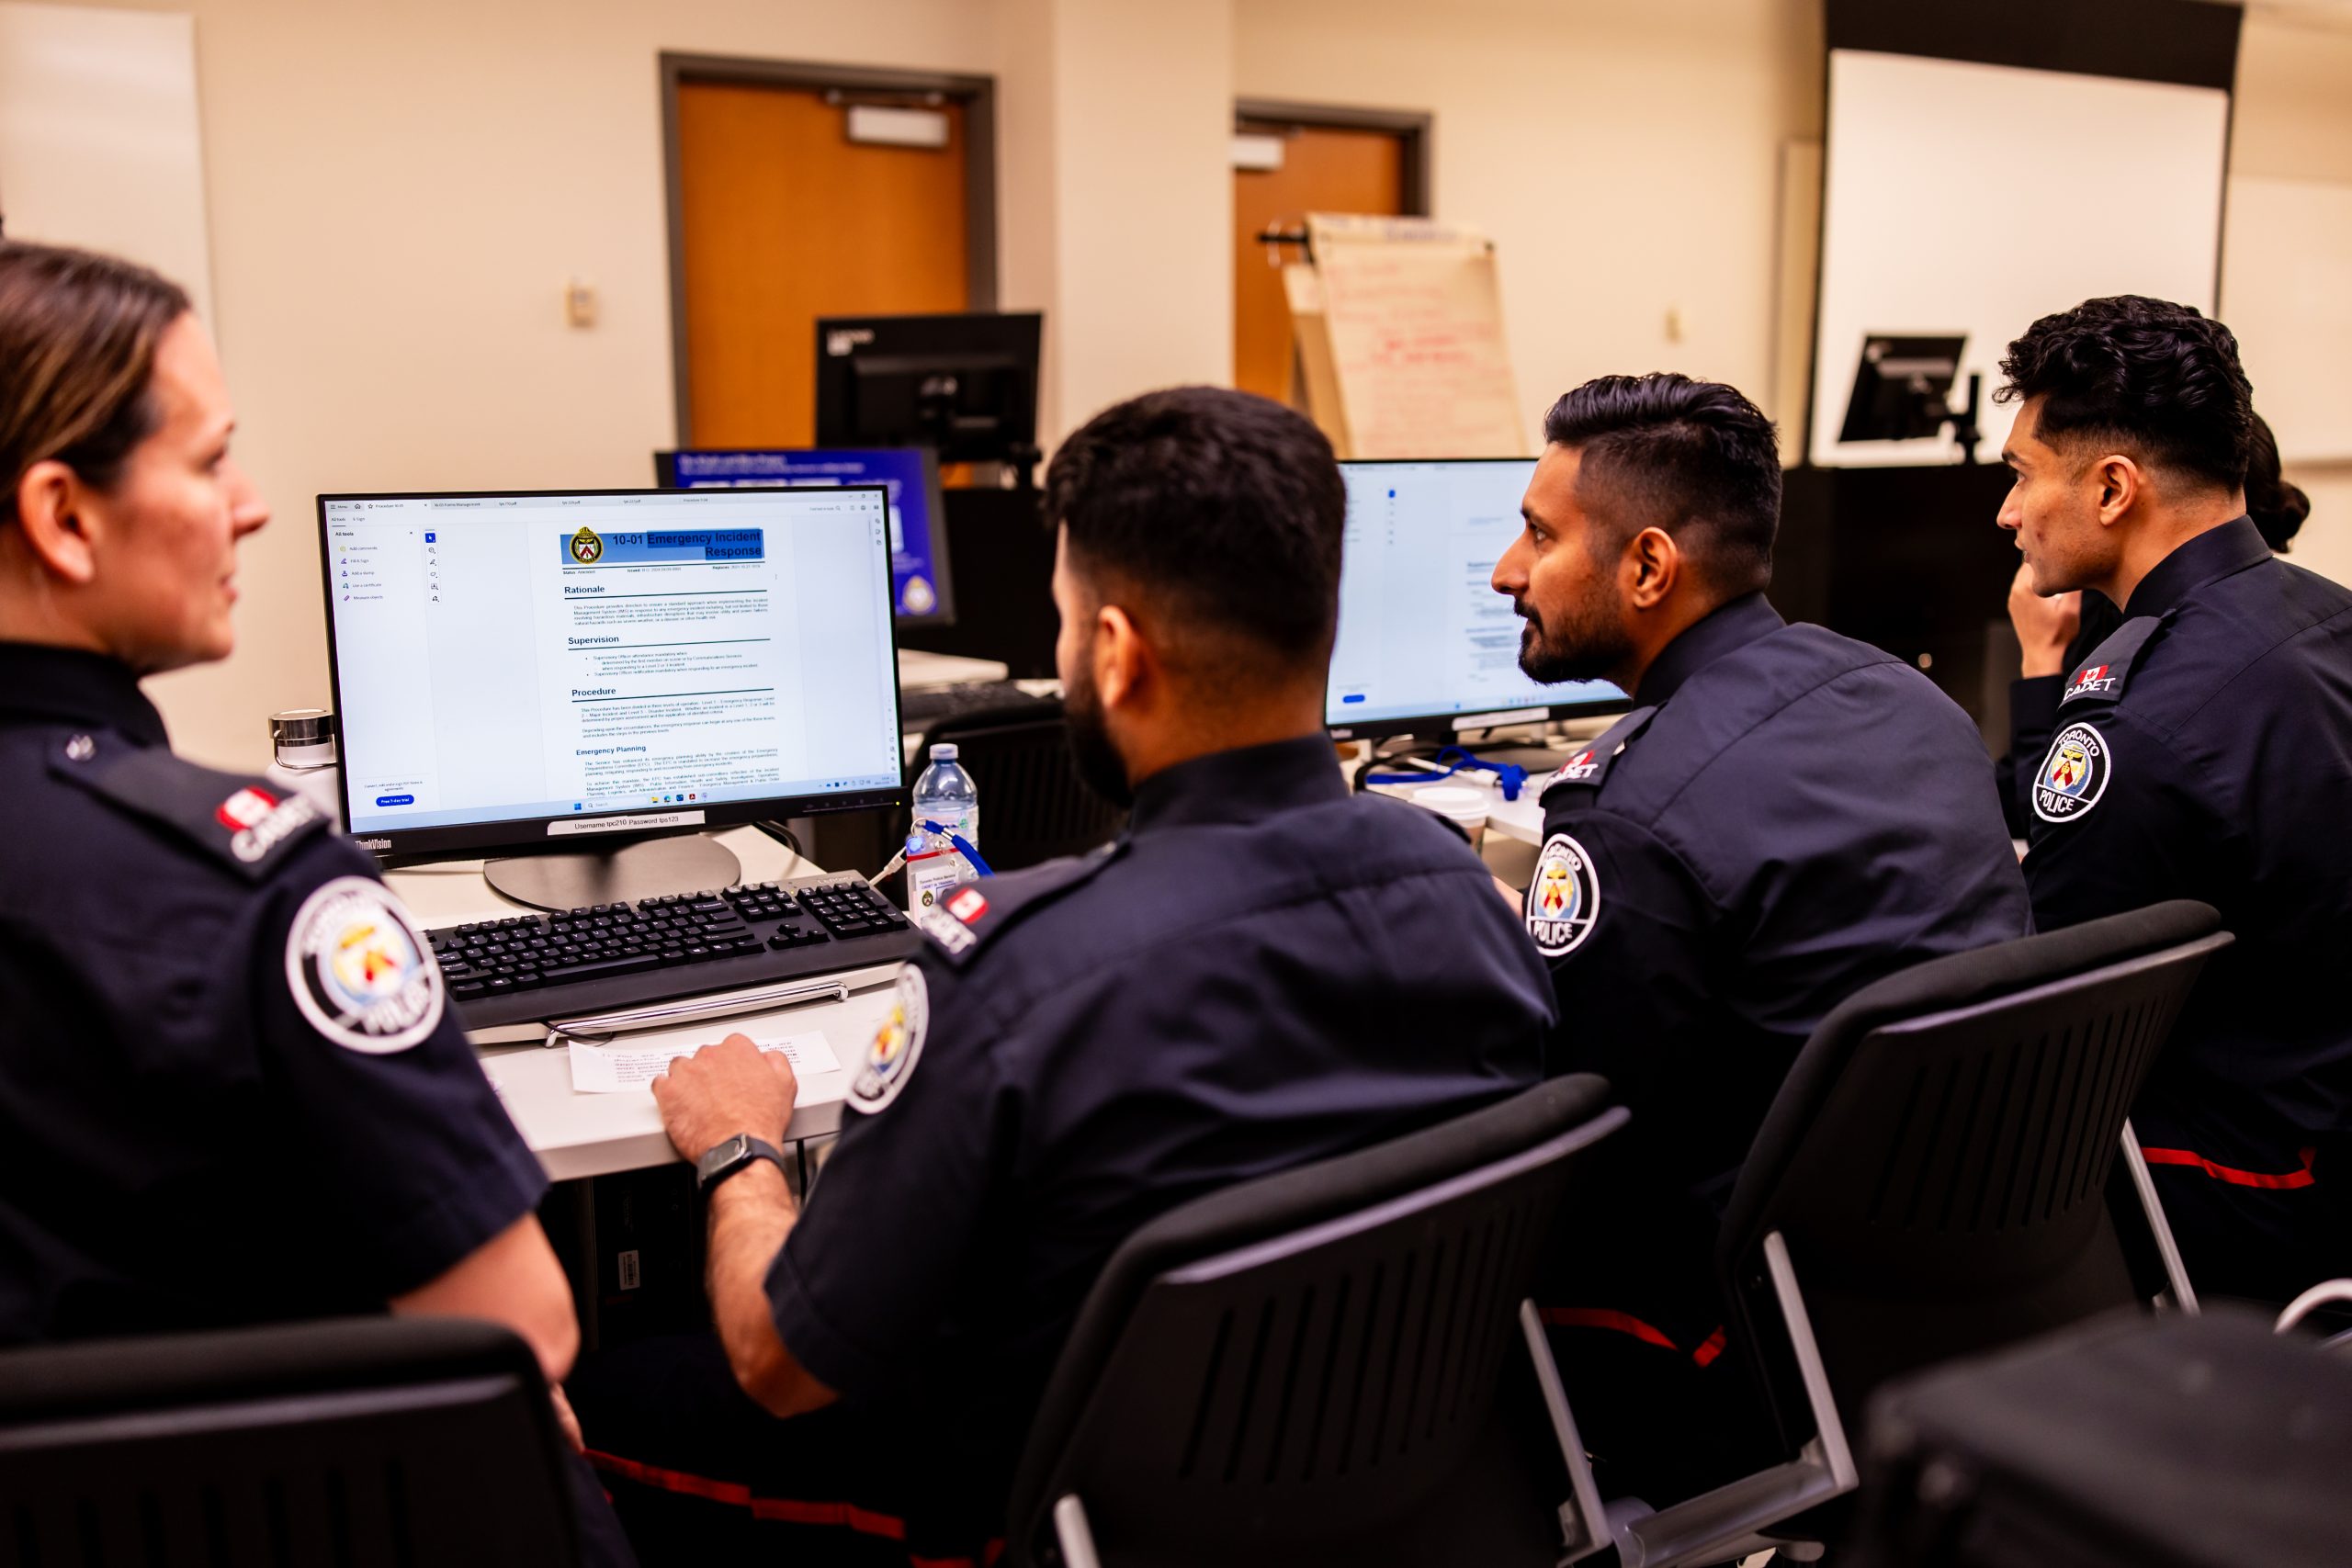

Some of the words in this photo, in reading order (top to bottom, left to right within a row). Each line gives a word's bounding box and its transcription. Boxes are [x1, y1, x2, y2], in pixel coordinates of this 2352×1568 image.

[613, 535, 643, 545] 10-01
[648, 534, 712, 547] Emergency
[716, 532, 761, 542] Incident
[706, 546, 762, 558] Response
[564, 585, 605, 594] Rationale
[568, 636, 619, 646] Supervision
[571, 687, 616, 697] Procedure
[2064, 677, 2117, 701] CADET
[2058, 729, 2100, 758] TORONTO
[576, 747, 615, 757] Emergency
[616, 744, 647, 754] Planning
[2039, 789, 2075, 813] POLICE
[606, 819, 627, 828] tpc210
[628, 818, 658, 826] Password
[659, 816, 679, 824] tps123
[355, 838, 392, 851] ThinkVision
[1534, 920, 1573, 945] POLICE
